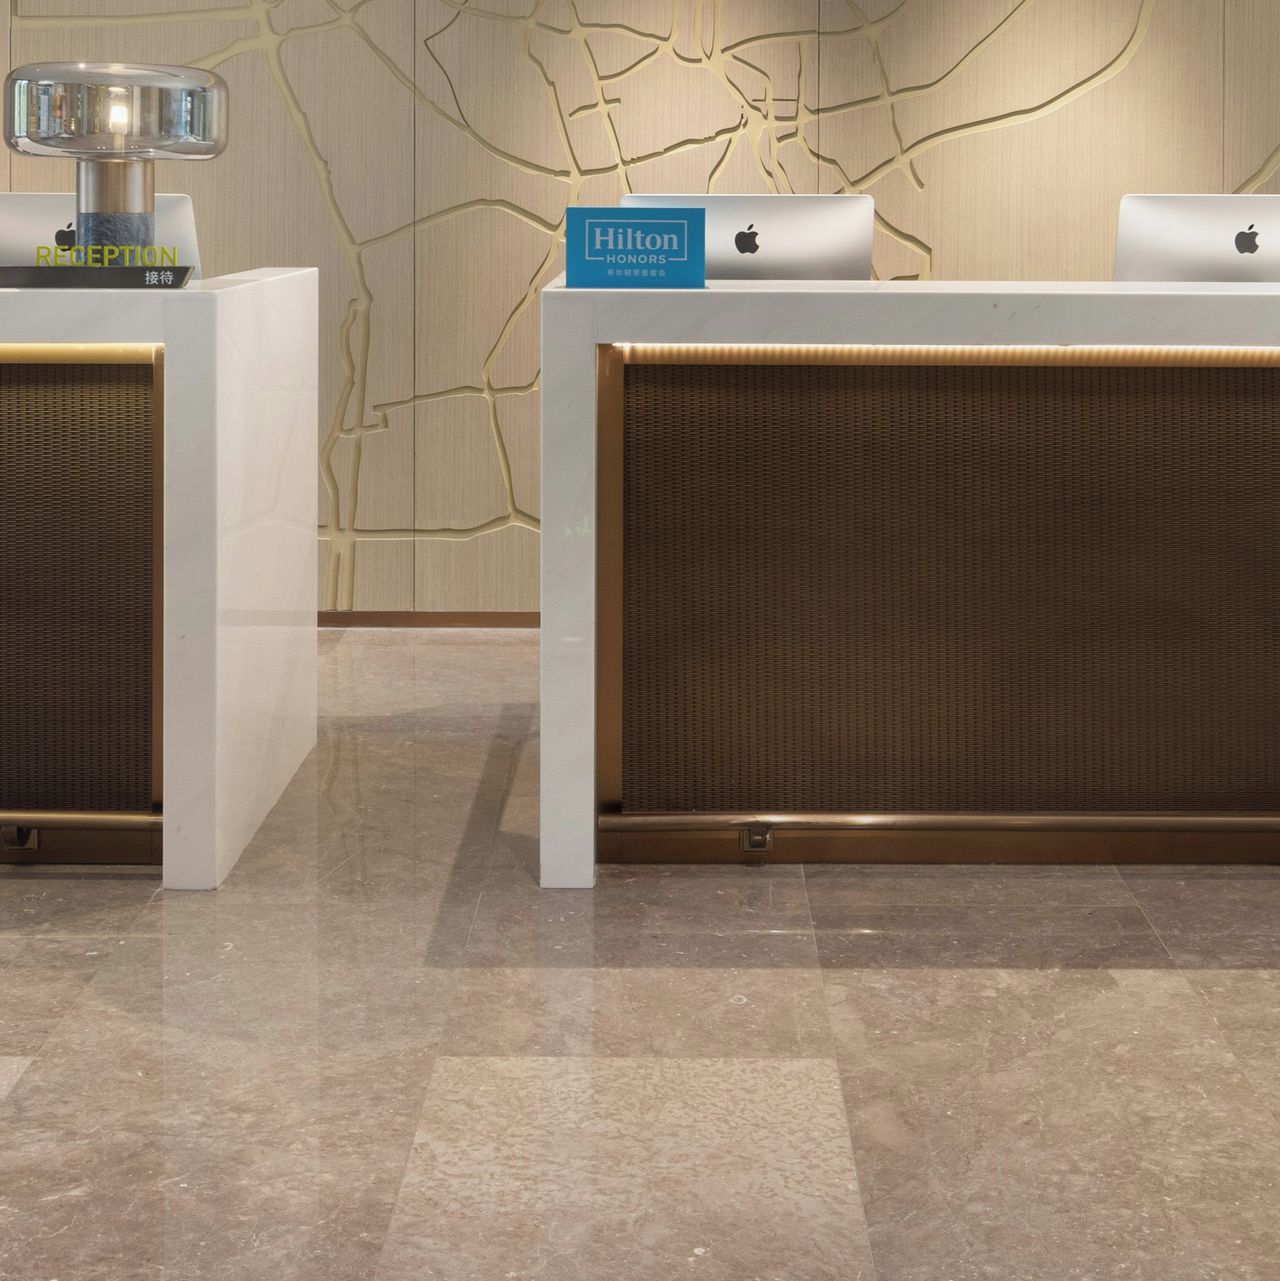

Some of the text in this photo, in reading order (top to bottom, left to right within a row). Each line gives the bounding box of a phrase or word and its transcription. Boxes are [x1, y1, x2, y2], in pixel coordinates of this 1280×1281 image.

[594, 227, 679, 251] Hilton
[36, 245, 178, 267] RECEPTION
[606, 254, 667, 264] HONORS
[144, 270, 174, 286] 接待
